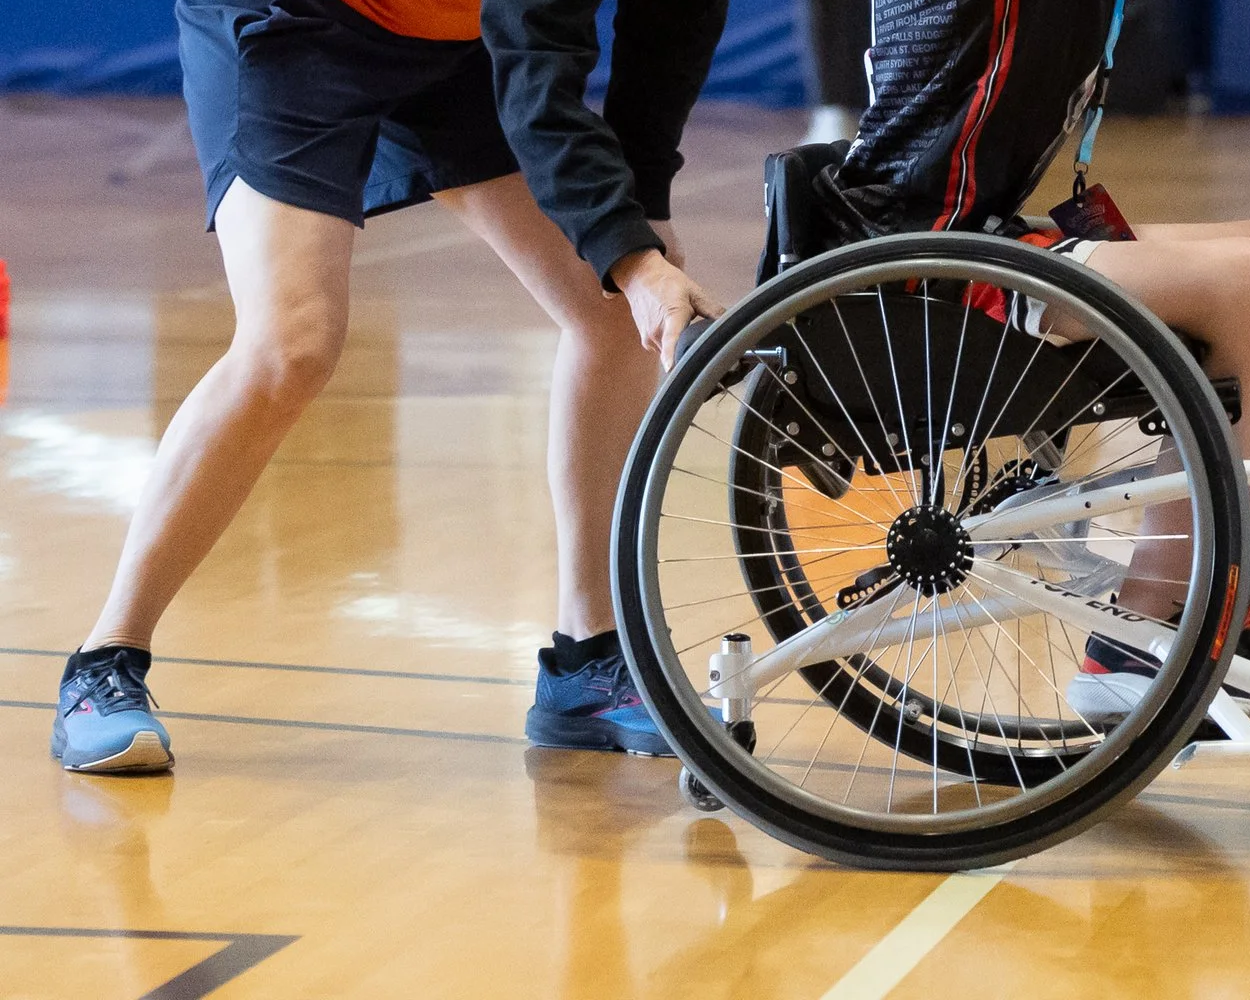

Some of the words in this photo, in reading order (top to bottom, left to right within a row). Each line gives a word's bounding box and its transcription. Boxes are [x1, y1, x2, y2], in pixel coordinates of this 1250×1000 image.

[883, 1, 913, 20] STATION
[895, 13, 917, 28] IRON
[891, 31, 913, 42] FALLS
[890, 57, 919, 69] SYDNEY
